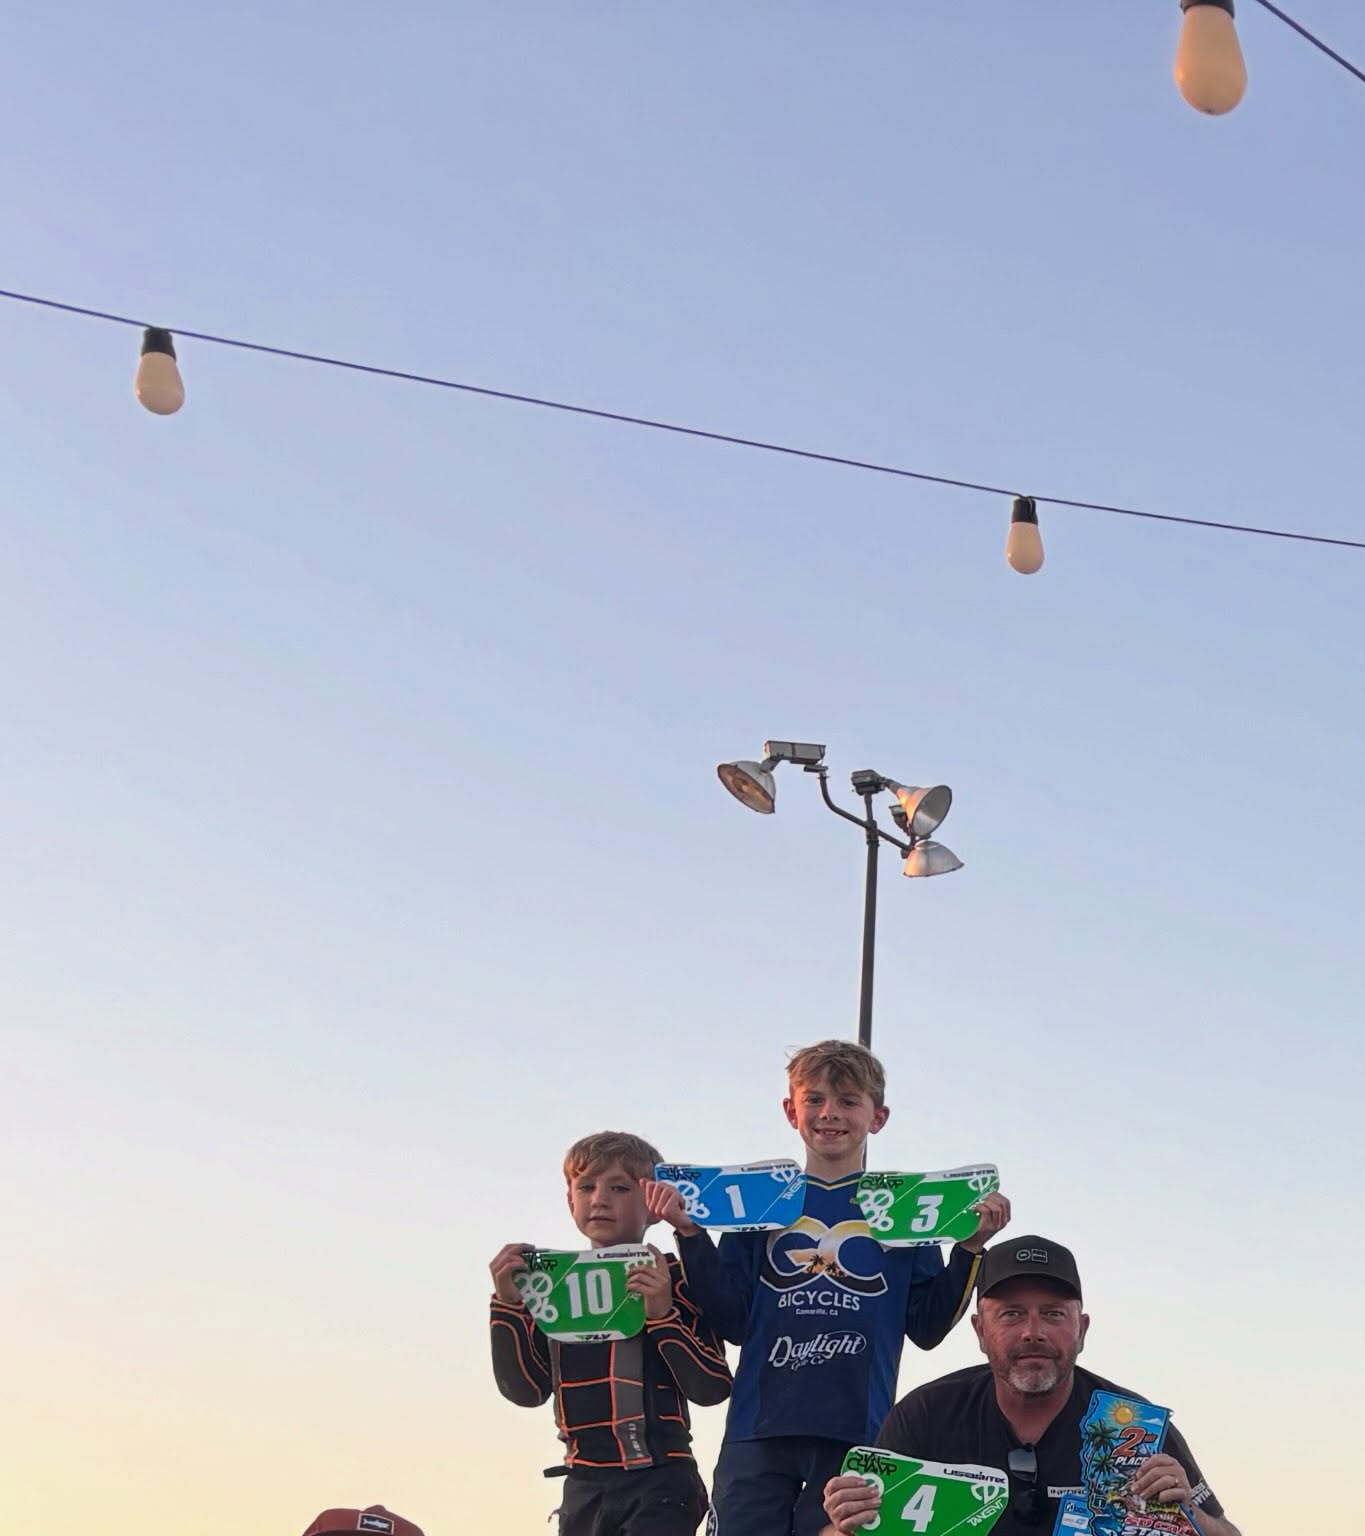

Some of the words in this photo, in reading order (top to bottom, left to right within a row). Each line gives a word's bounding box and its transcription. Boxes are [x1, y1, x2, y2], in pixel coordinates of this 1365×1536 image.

[725, 1185, 746, 1218] 1
[911, 1195, 944, 1232] 3
[566, 1269, 613, 1319] 10
[778, 1291, 860, 1311] BICYCLES
[768, 1330, 867, 1368] Daylight
[901, 1484, 937, 1533] 4
[967, 1500, 1003, 1527] TANGENT
